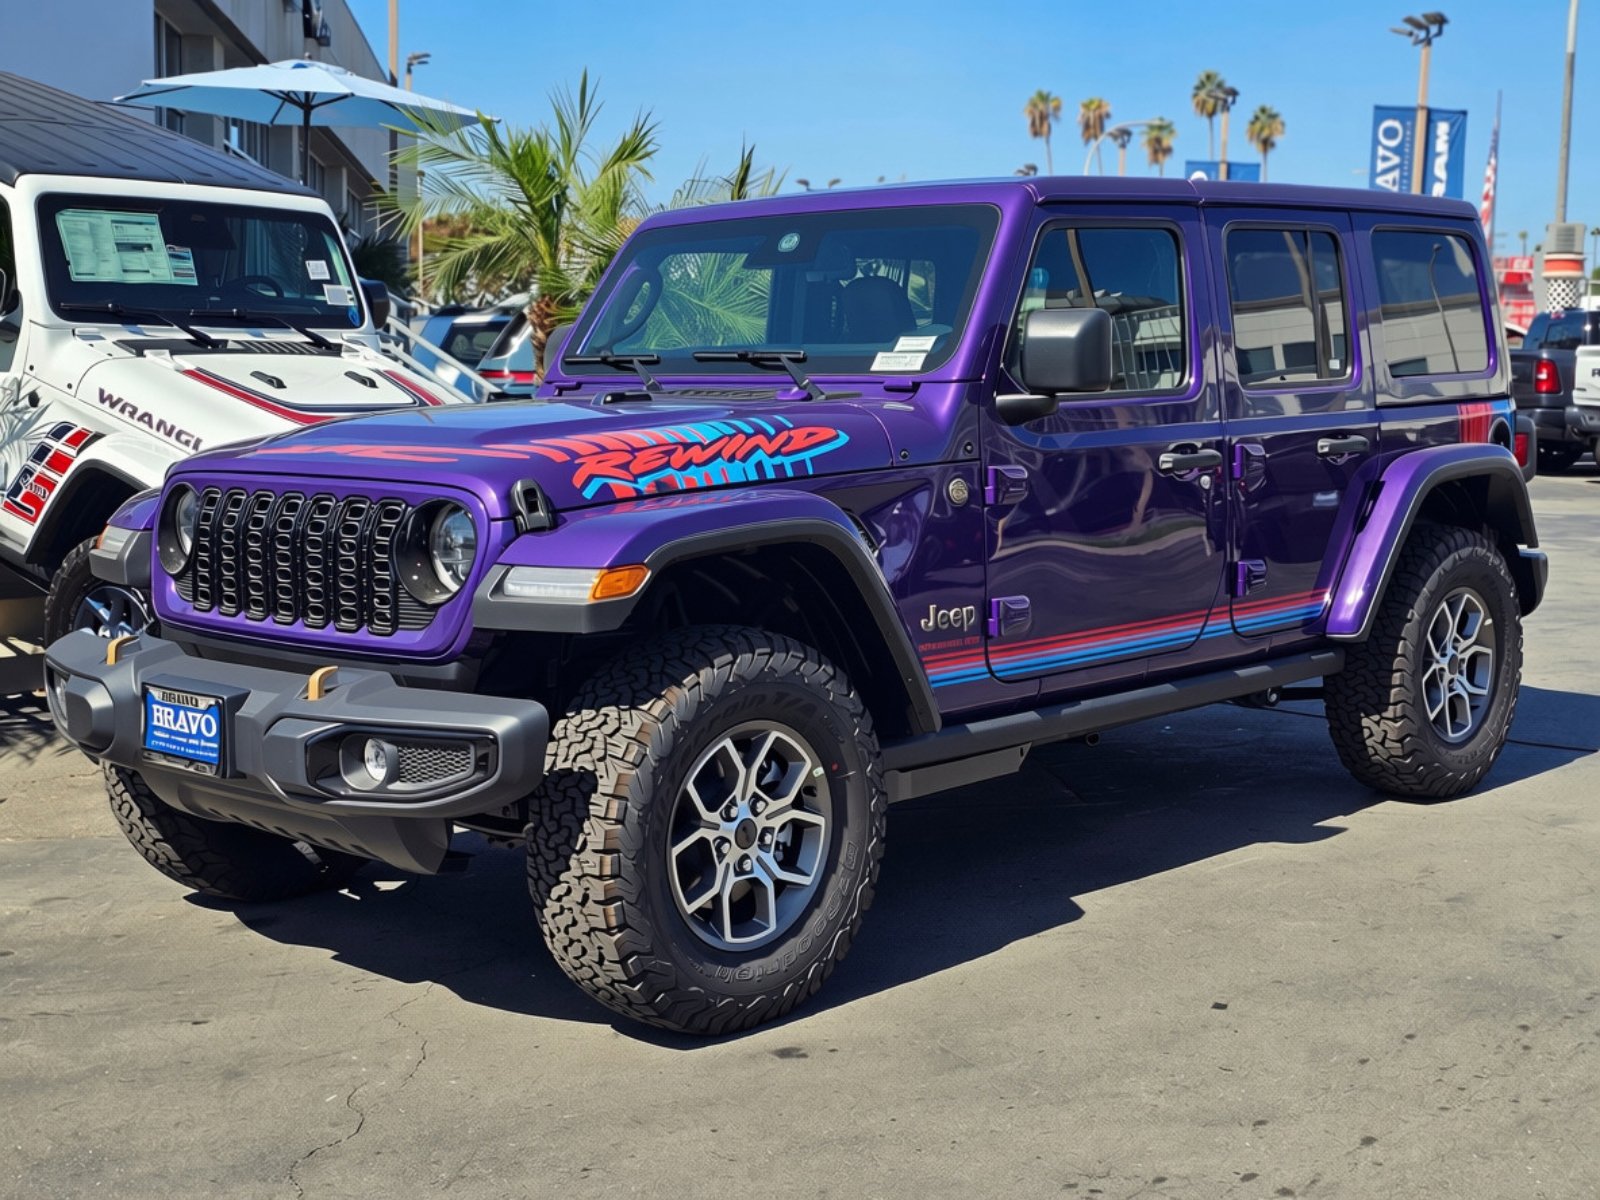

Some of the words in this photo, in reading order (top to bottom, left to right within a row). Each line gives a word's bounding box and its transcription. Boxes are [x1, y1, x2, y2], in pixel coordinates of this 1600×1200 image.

[1375, 118, 1404, 194] AVO
[571, 426, 840, 490] REWIND
[920, 604, 975, 632] Jeep
[152, 703, 218, 738] BRAVO
